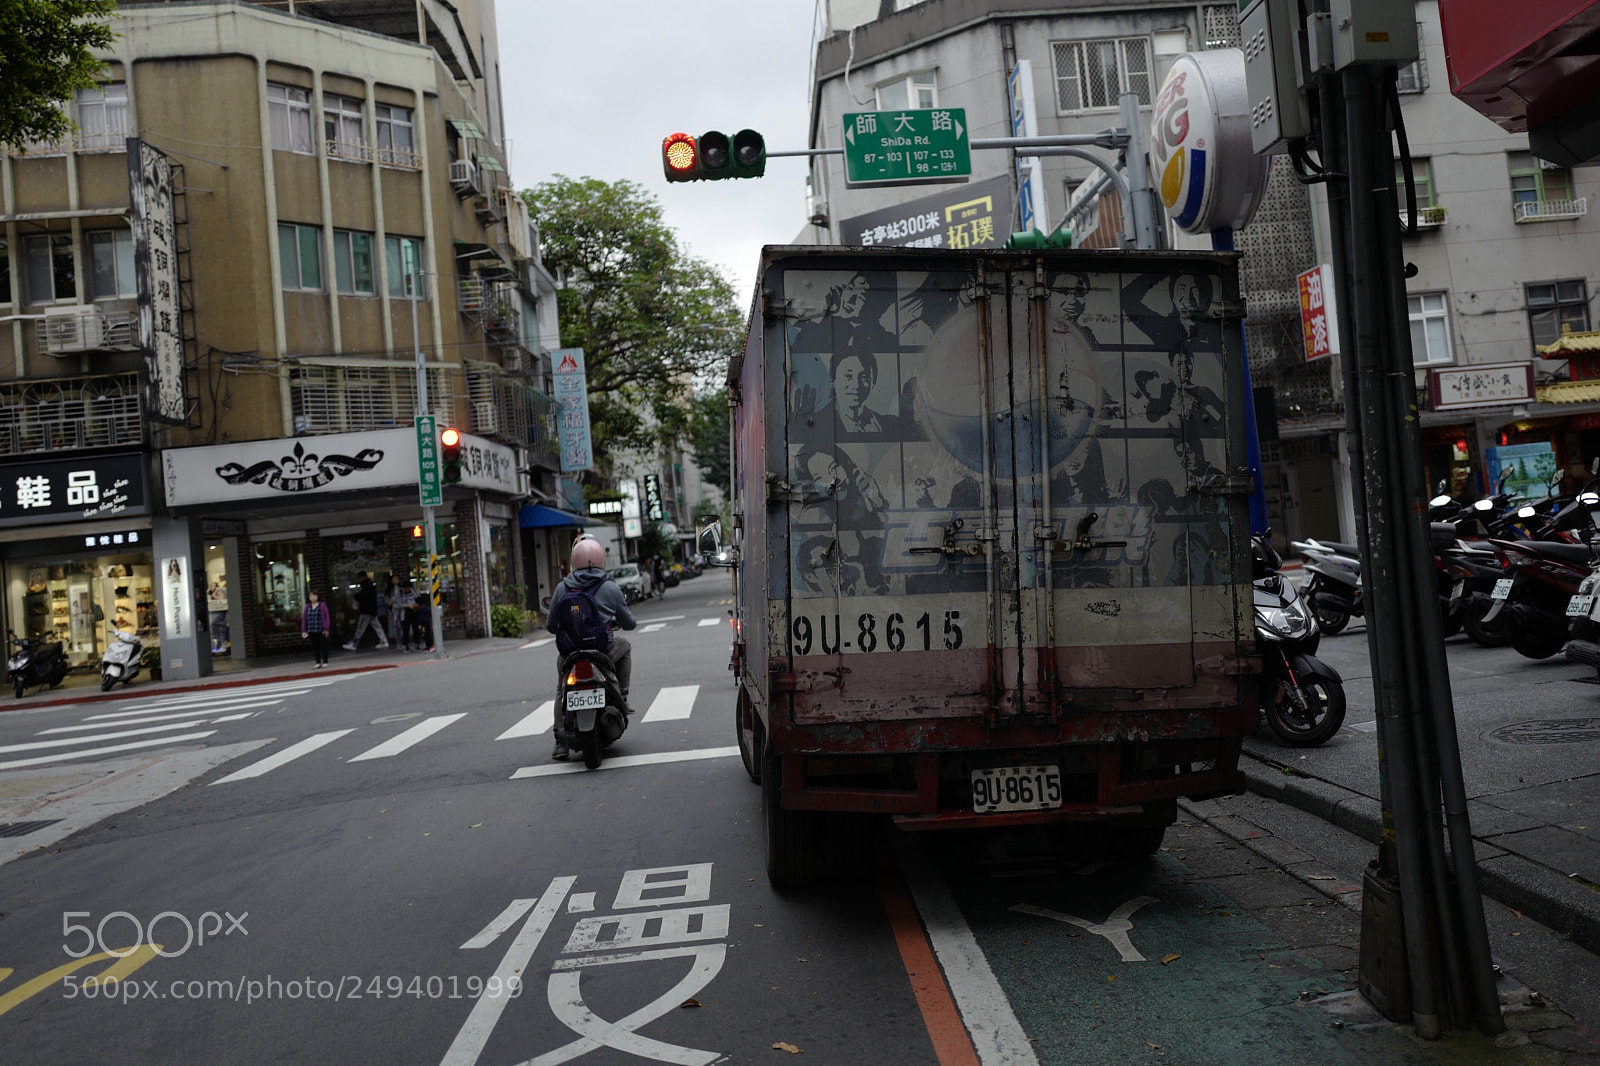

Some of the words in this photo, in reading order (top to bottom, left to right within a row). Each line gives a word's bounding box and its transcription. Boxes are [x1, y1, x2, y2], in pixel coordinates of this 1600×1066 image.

[856, 110, 953, 135] 師大路
[881, 136, 912, 147] ShiDa
[915, 135, 931, 146] Rd.
[860, 211, 941, 247] 古亭站300米
[1306, 271, 1328, 354] 油漆
[560, 374, 586, 467] 全家福牙醫
[0, 470, 100, 510] 鞋品
[793, 610, 963, 656] 9U-8615
[568, 694, 604, 707] 505-CXE
[973, 774, 1061, 806] 9U-8615
[440, 862, 731, 1066] 慢
